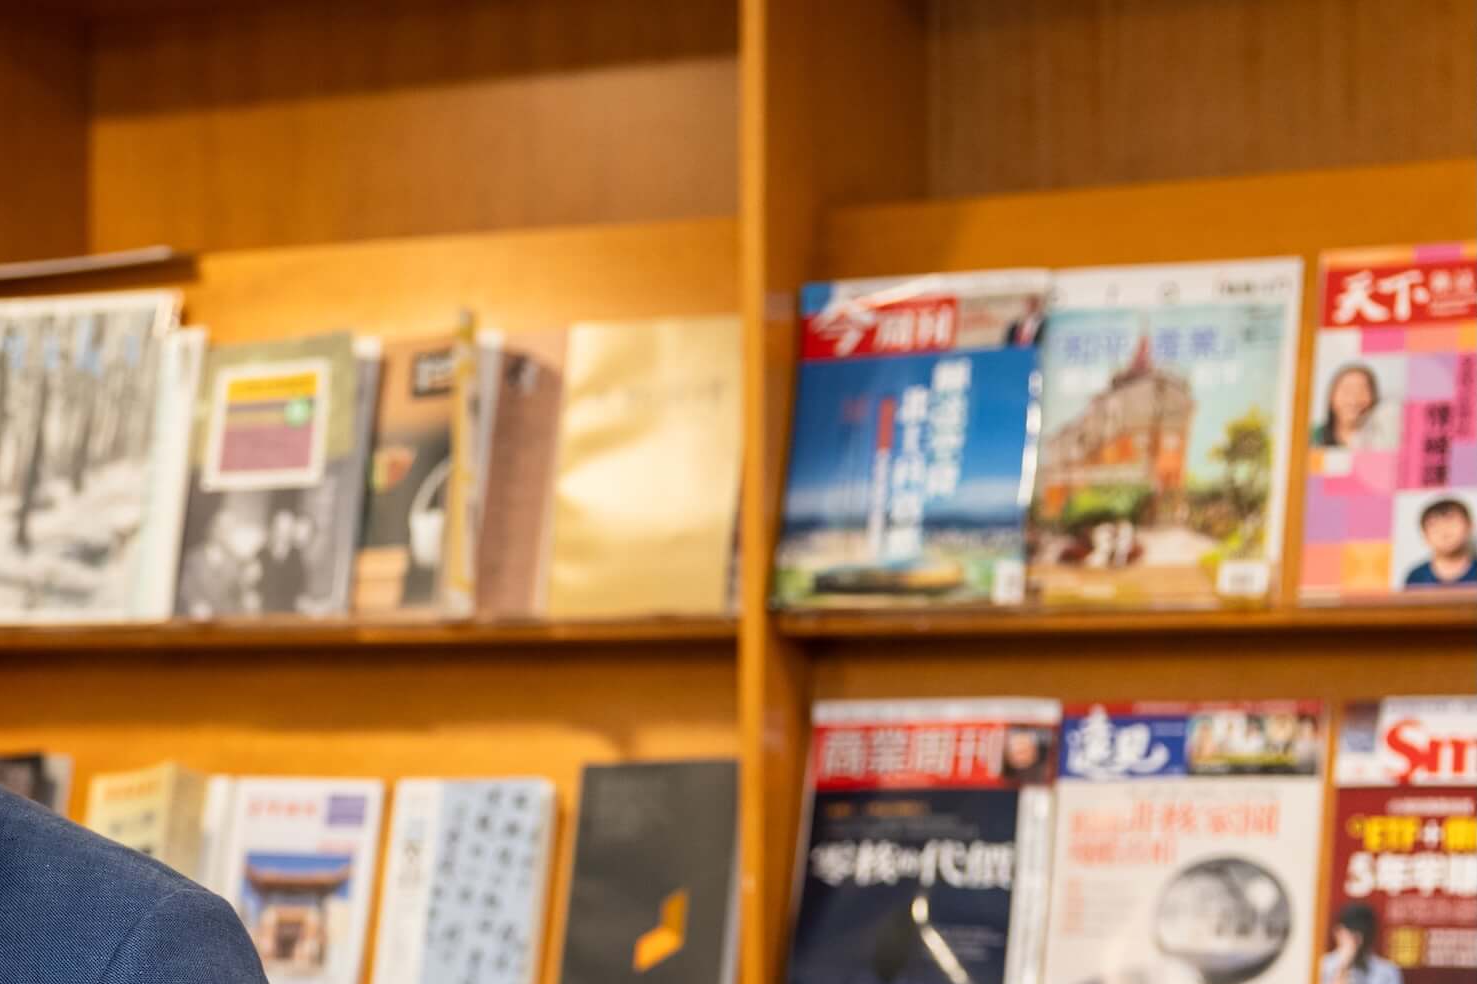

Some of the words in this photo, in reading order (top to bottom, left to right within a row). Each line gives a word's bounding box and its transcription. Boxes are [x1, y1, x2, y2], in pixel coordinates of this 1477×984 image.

[1332, 269, 1430, 324] 天下
[825, 726, 1006, 778] 商業周刊
[1066, 703, 1170, 781] 遠見
[1069, 800, 1281, 838] 非核家園
